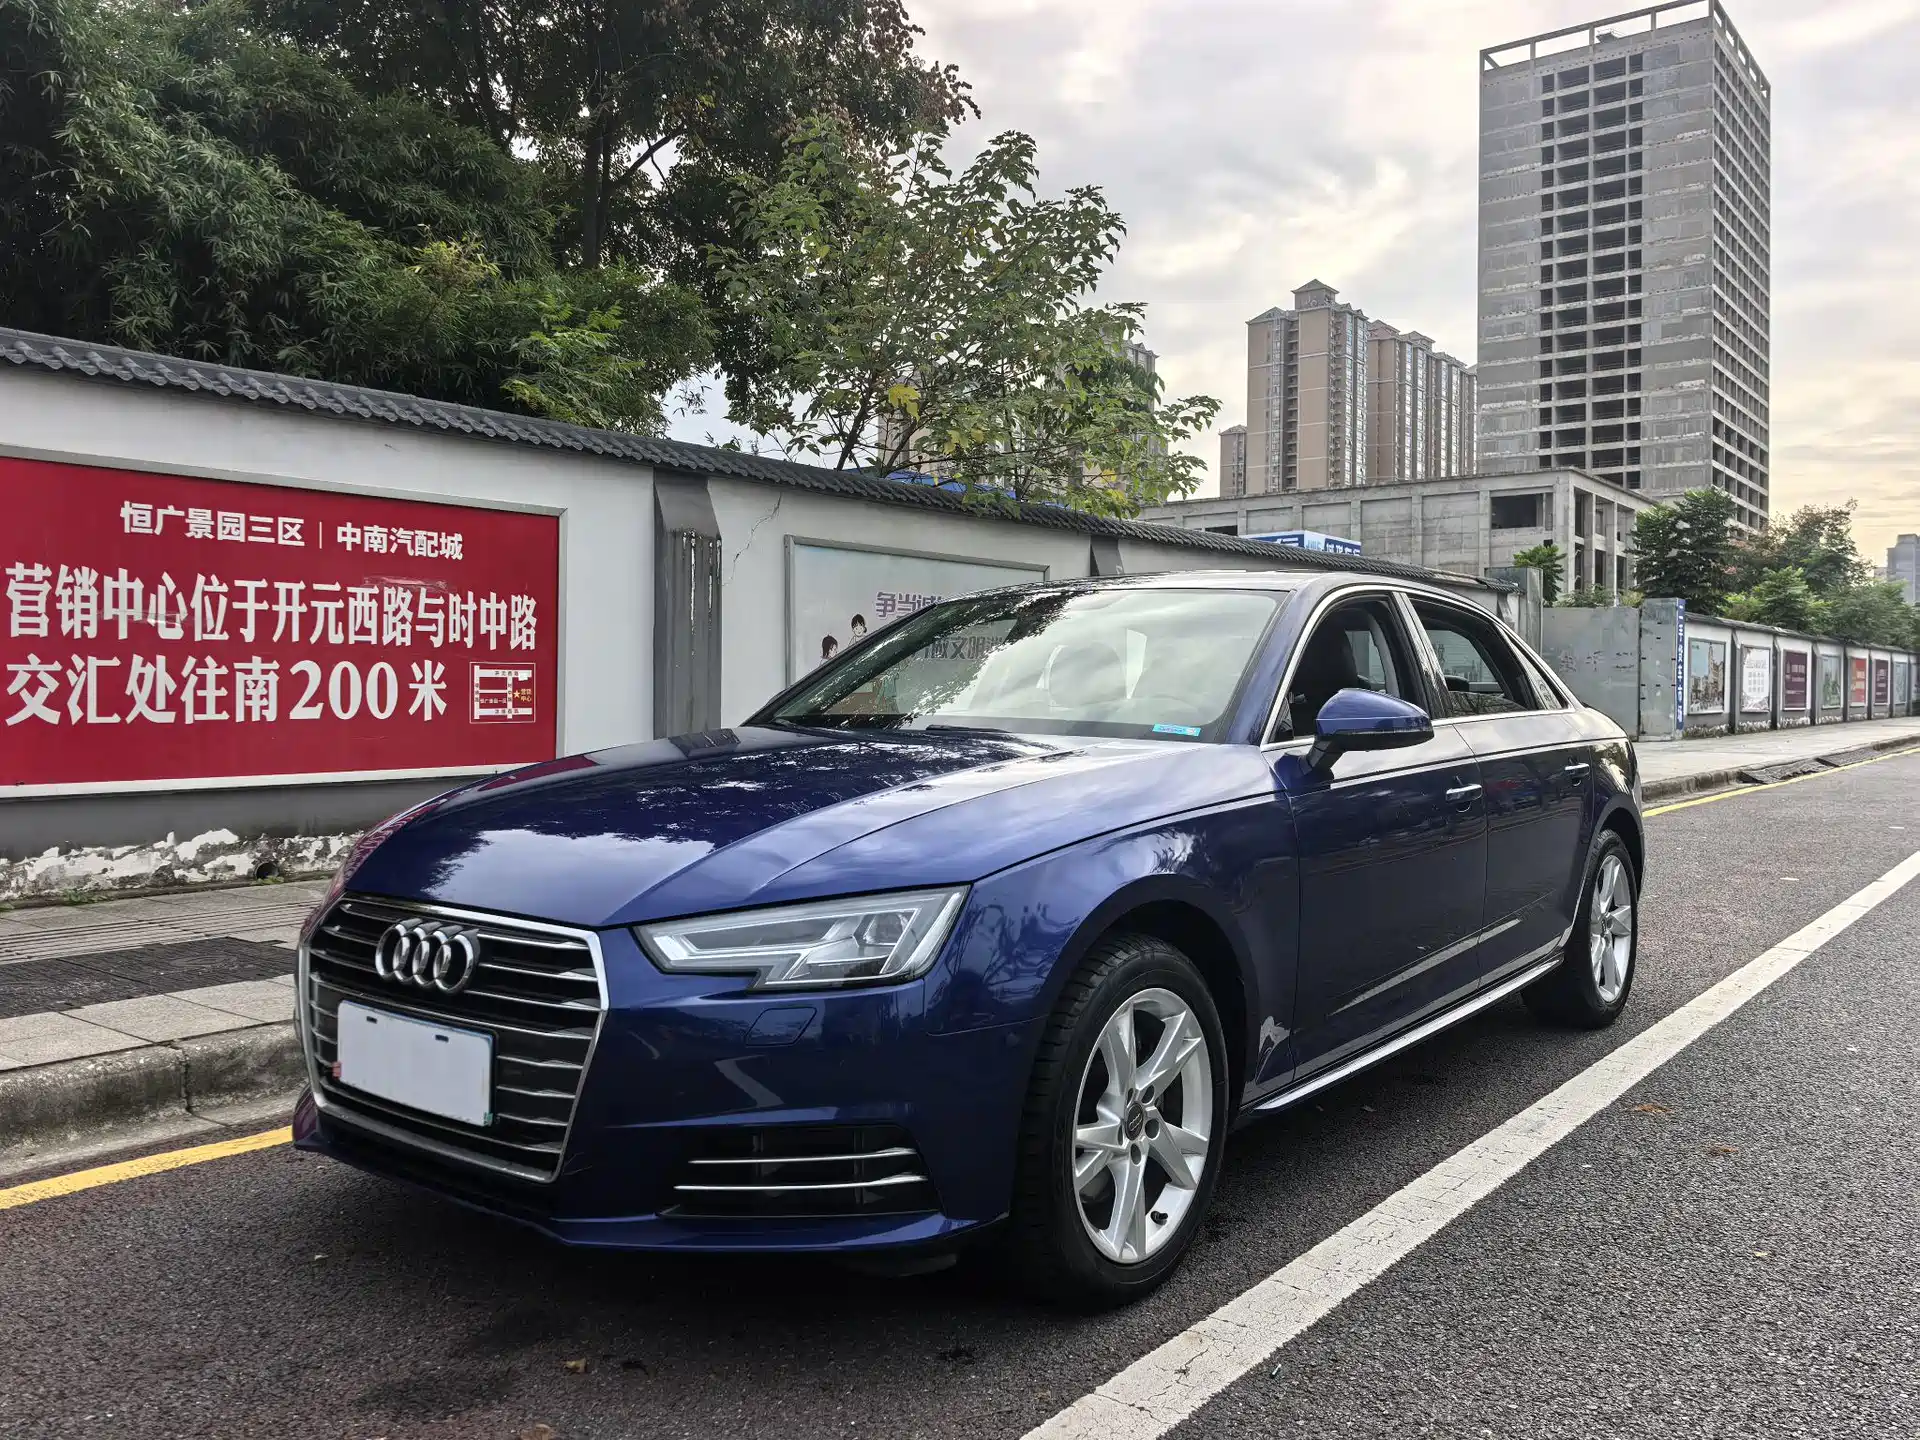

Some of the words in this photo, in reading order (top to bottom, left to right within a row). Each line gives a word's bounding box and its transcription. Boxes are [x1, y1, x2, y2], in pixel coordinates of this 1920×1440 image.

[120, 501, 305, 546] 恒广景园三区
[337, 522, 463, 560] 中南汽配城
[5, 561, 537, 650] 营销中心位于开元西路与时中路
